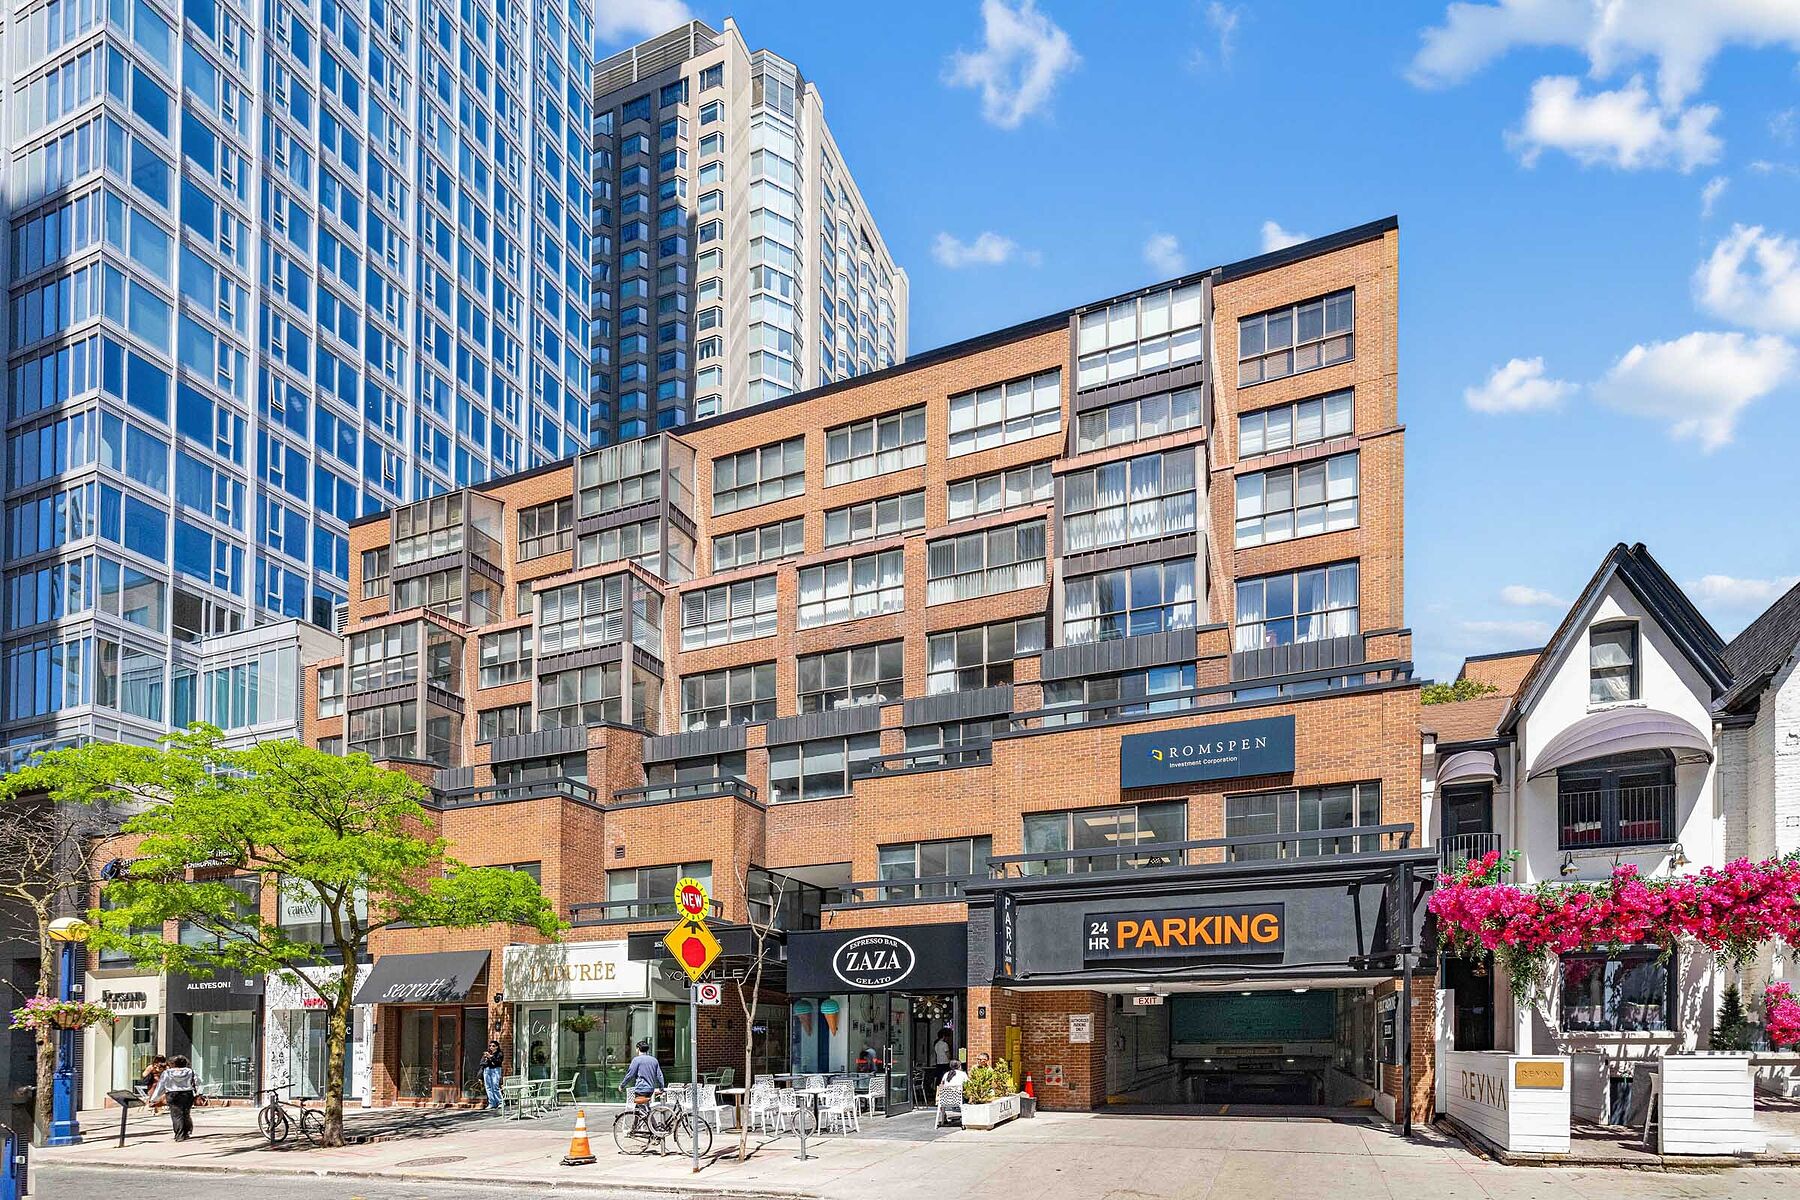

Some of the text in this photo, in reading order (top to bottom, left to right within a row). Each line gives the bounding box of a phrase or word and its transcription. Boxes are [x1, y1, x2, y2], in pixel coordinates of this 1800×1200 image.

[1169, 736, 1267, 758] ROMSPEN
[1169, 756, 1238, 768] Investment Corporation
[681, 892, 702, 908] NEW
[1004, 896, 1012, 955] PARK
[1090, 922, 1109, 935] 24
[1117, 913, 1279, 949] PARKING
[849, 937, 898, 950] ESPRESSO BAR
[1088, 937, 1110, 950] HR
[845, 950, 902, 971] ZAZA
[529, 961, 616, 982] LADURÉE
[665, 969, 745, 981] YOVILLE
[200, 982, 217, 990] EYES
[217, 981, 228, 989] ON
[855, 976, 891, 985] GELATO
[1138, 997, 1157, 1005] EXIT
[1521, 1070, 1559, 1080] REYNA
[1462, 1070, 1507, 1111] REYNA
